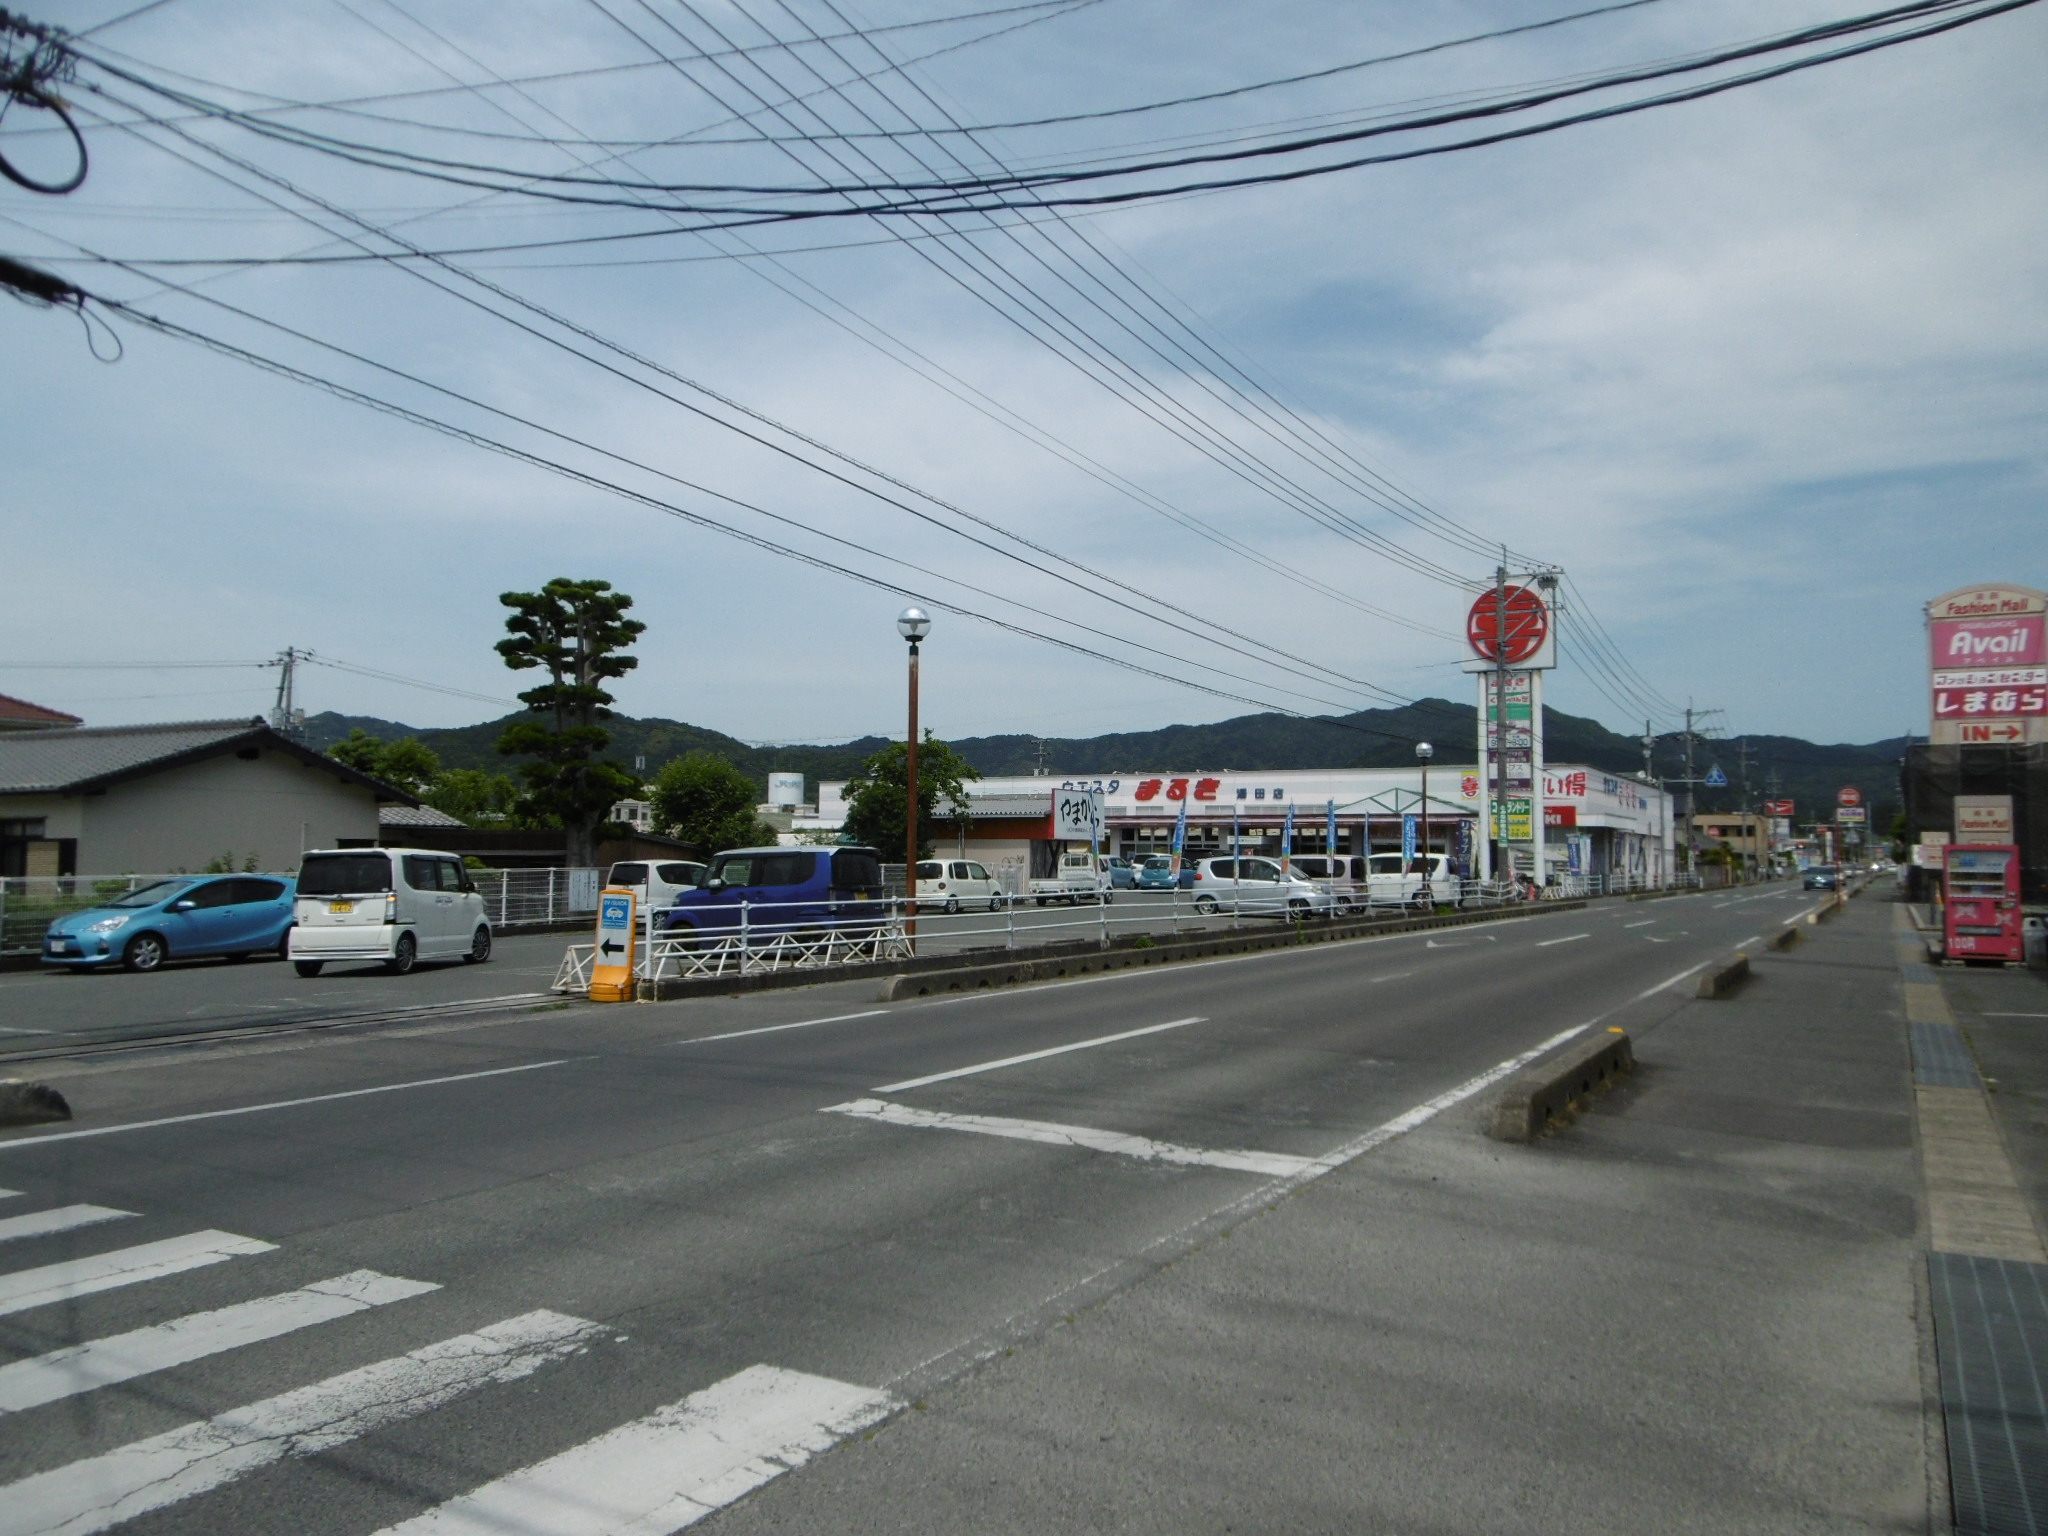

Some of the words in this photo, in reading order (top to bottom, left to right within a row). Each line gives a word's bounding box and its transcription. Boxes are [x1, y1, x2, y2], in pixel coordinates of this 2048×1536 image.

[1948, 602, 1997, 615] Fashion
[2001, 599, 2029, 612] Mall
[1949, 628, 2028, 656] Avail
[1936, 671, 2045, 686] ファッションセンター
[1936, 689, 2046, 714] しまむら
[1962, 725, 1991, 742] IN
[1134, 778, 1220, 801] まるき
